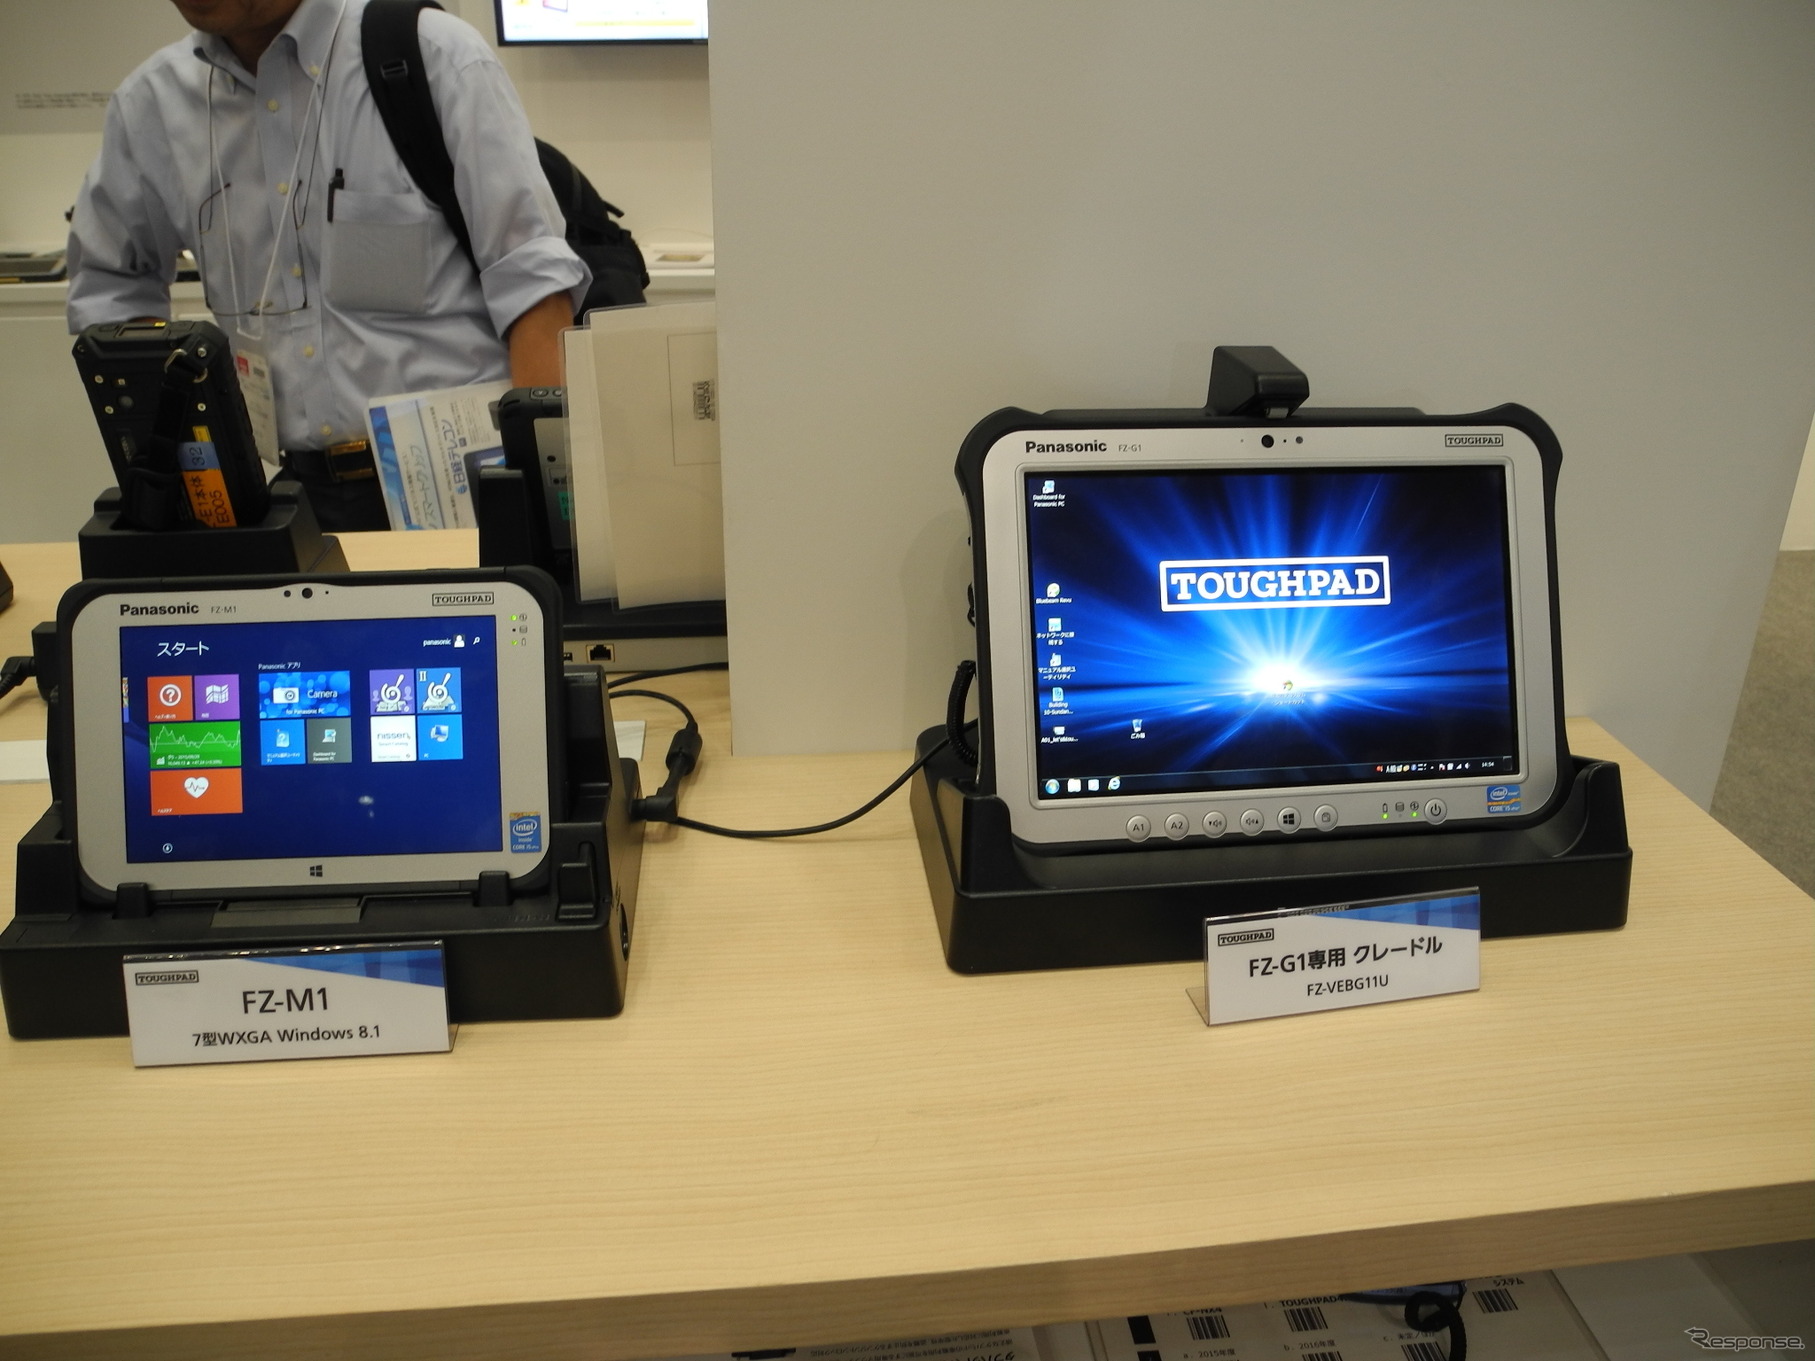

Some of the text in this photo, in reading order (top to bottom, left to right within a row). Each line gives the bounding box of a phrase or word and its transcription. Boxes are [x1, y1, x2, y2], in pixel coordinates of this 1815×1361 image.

[1025, 439, 1142, 453] Panasonic FZ-G1
[1447, 435, 1502, 446] TOUGHPAD
[441, 419, 466, 485] 日経テレコン
[410, 444, 437, 529] スマートクリップ
[191, 475, 213, 522] E1本体
[209, 490, 230, 525] E005
[1170, 566, 1381, 602] TOUGHPAD
[434, 594, 492, 605] TOUGHPAD
[120, 602, 237, 616] Panasonic FZ-M1
[157, 641, 210, 657] スタート
[423, 638, 451, 647] panasonic
[307, 689, 338, 699] Camera
[1492, 789, 1505, 797] intel
[516, 822, 534, 832] intel
[1132, 824, 1145, 832] A1
[1170, 821, 1184, 830] A2
[1219, 930, 1273, 944] TOUGHPAD
[1249, 936, 1443, 978] FZ-G1専用 クレードル
[137, 972, 197, 984] TOUGHPAD
[1307, 974, 1389, 997] FZ-VEBG11U
[242, 987, 330, 1015] FZ-M1
[192, 1025, 380, 1047] 7型WXGA Windows 8.1
[1493, 1277, 1525, 1288] システム
[1198, 1348, 1236, 1358] 2015年度
